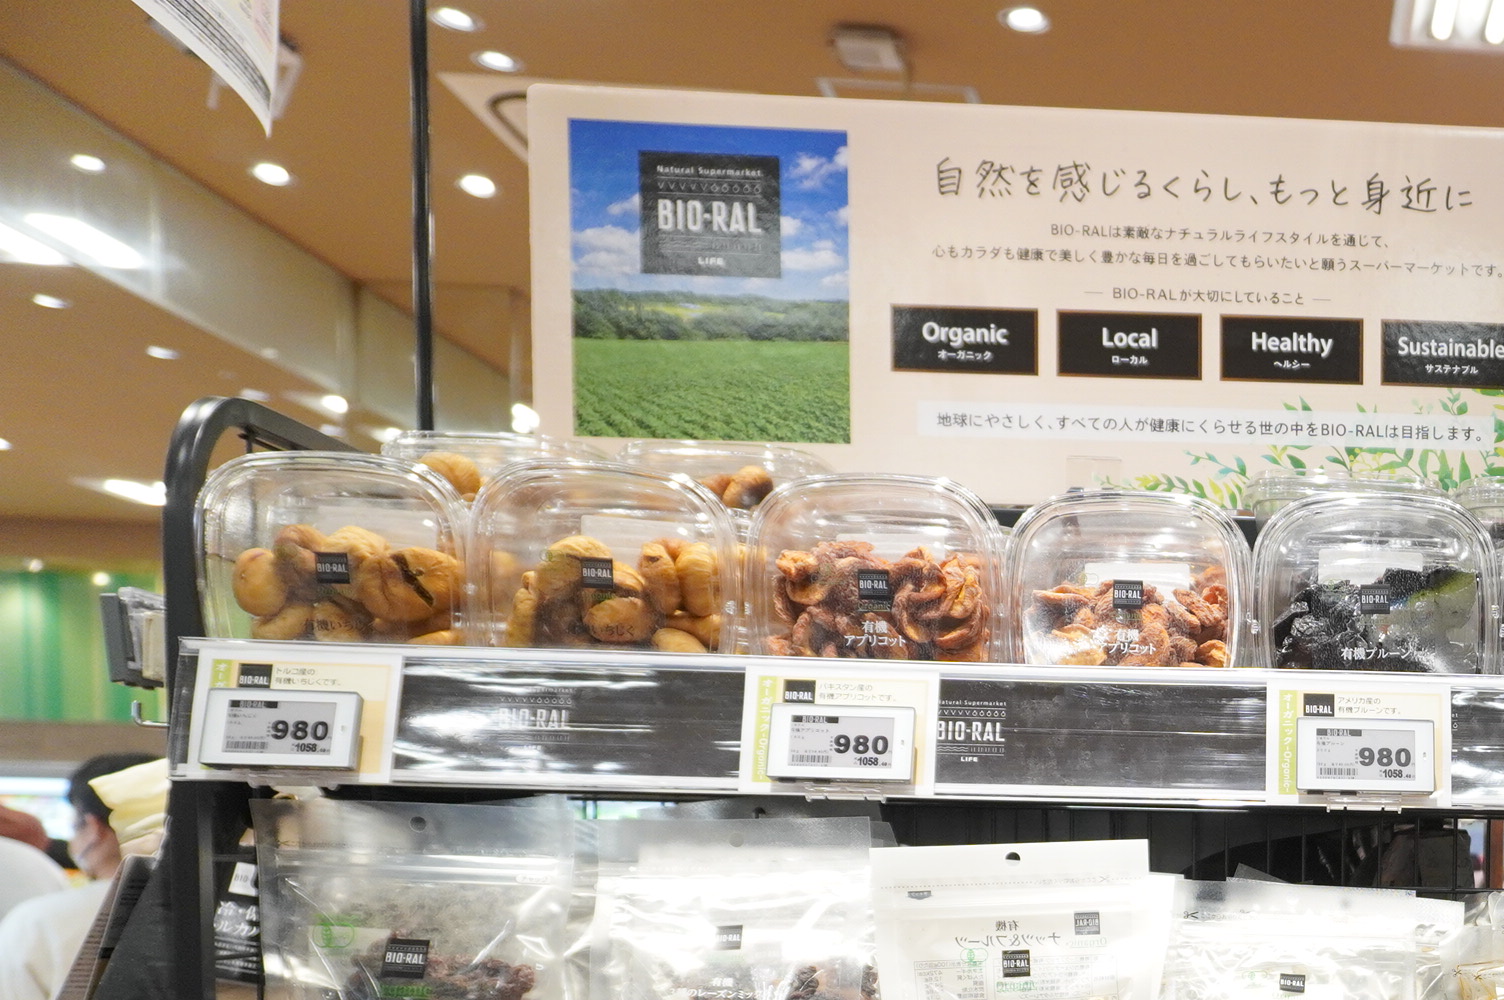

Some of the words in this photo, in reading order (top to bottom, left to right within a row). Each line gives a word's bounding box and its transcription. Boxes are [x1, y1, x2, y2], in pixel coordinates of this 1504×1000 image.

[656, 165, 695, 175] Natural
[698, 166, 762, 177] Supermarket
[935, 156, 1474, 215] 自然を感じるくらし、もっと身近に
[657, 198, 763, 233] BIO-RAL
[697, 256, 725, 266] LIFE
[922, 321, 1010, 348] Organic
[1101, 327, 1158, 349] Local
[1251, 331, 1334, 358] Healthy
[937, 349, 993, 361] オーガニック
[1111, 354, 1149, 366] ローカル
[1273, 359, 1311, 370] ヘルシー
[1424, 364, 1479, 376] サステナブル
[316, 561, 349, 574] BIO-RAL
[581, 567, 613, 579] BIO-RAL
[859, 578, 889, 590] BIO-RAL
[1114, 588, 1143, 600] BIO-RAL
[1361, 594, 1388, 606] BIO-RAL
[861, 620, 888, 634] 有機
[844, 633, 907, 648] アプリコット
[1114, 628, 1140, 641] 有機
[1340, 647, 1411, 661] 有機プルーン
[239, 675, 269, 685] BIO-RAL
[784, 690, 813, 701] BIO-RAL
[1337, 696, 1381, 705] アメリカ産の
[963, 700, 1007, 708] Supermarket
[1305, 704, 1333, 714] BIO-RAL
[270, 719, 329, 741] 980
[937, 720, 1006, 742] BIO-RAL
[833, 734, 889, 755] 980
[1358, 747, 1412, 768] 980
[384, 951, 425, 966] BIO-RAL
[1003, 959, 1030, 969] BIO-RAL
[1279, 978, 1305, 988] BIO-RAL
